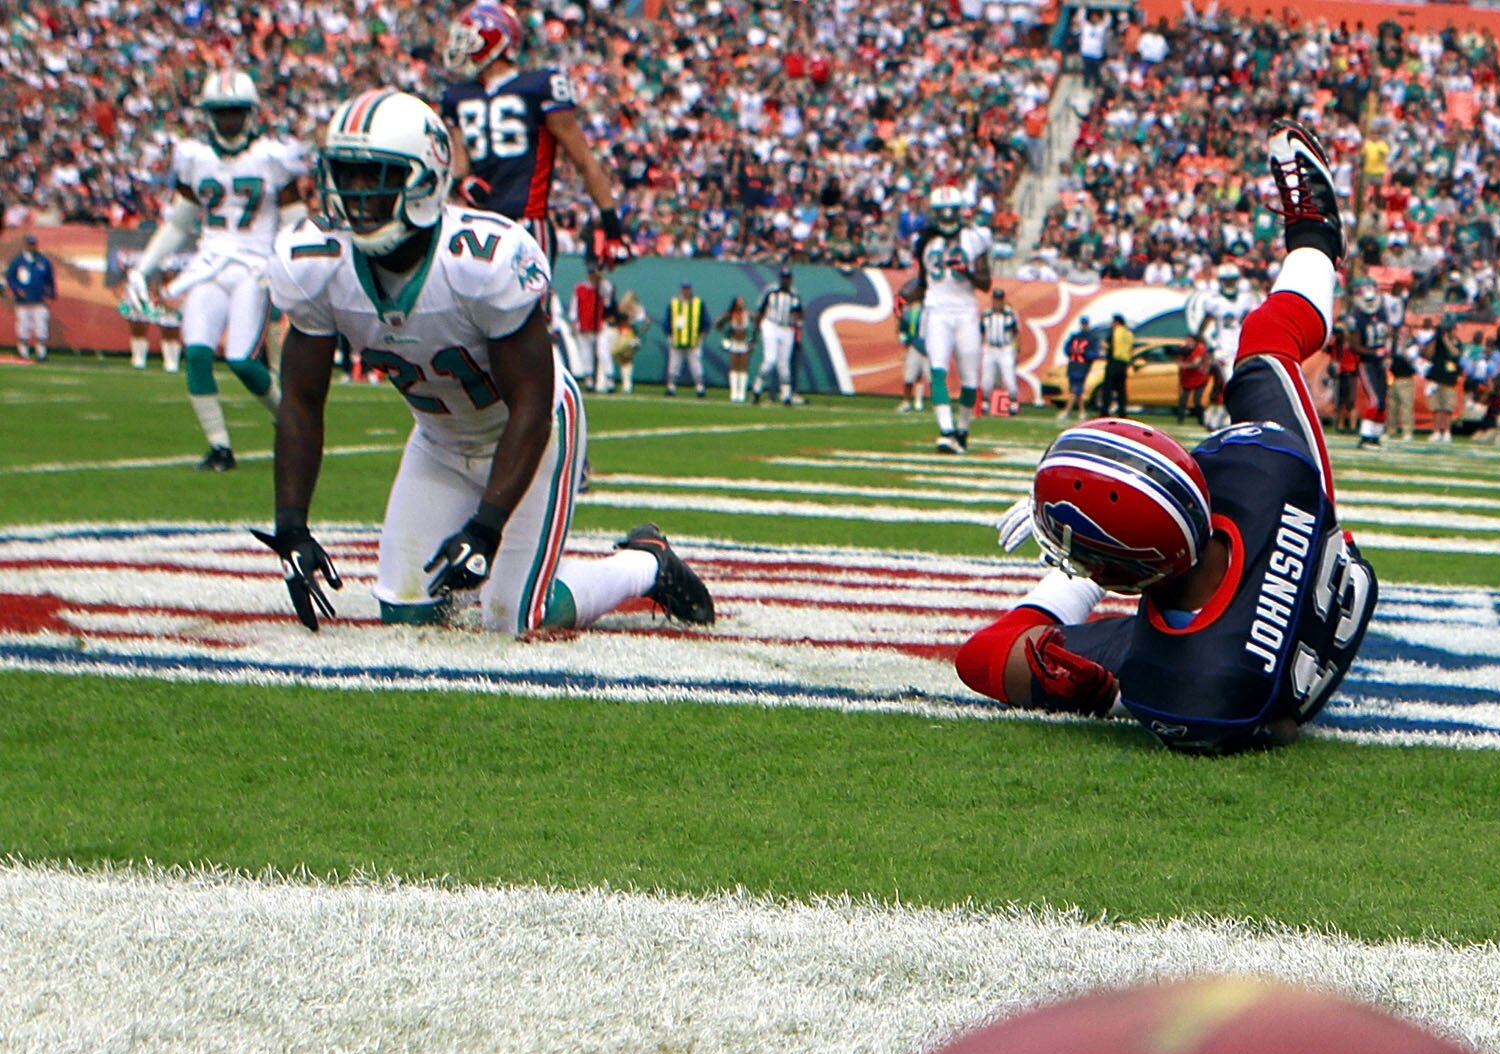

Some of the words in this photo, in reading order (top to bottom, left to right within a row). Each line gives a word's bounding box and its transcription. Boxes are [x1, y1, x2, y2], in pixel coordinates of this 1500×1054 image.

[457, 93, 530, 161] 86
[197, 175, 265, 231] 27
[361, 346, 501, 414] 21
[1245, 502, 1317, 674] JOHNSON
